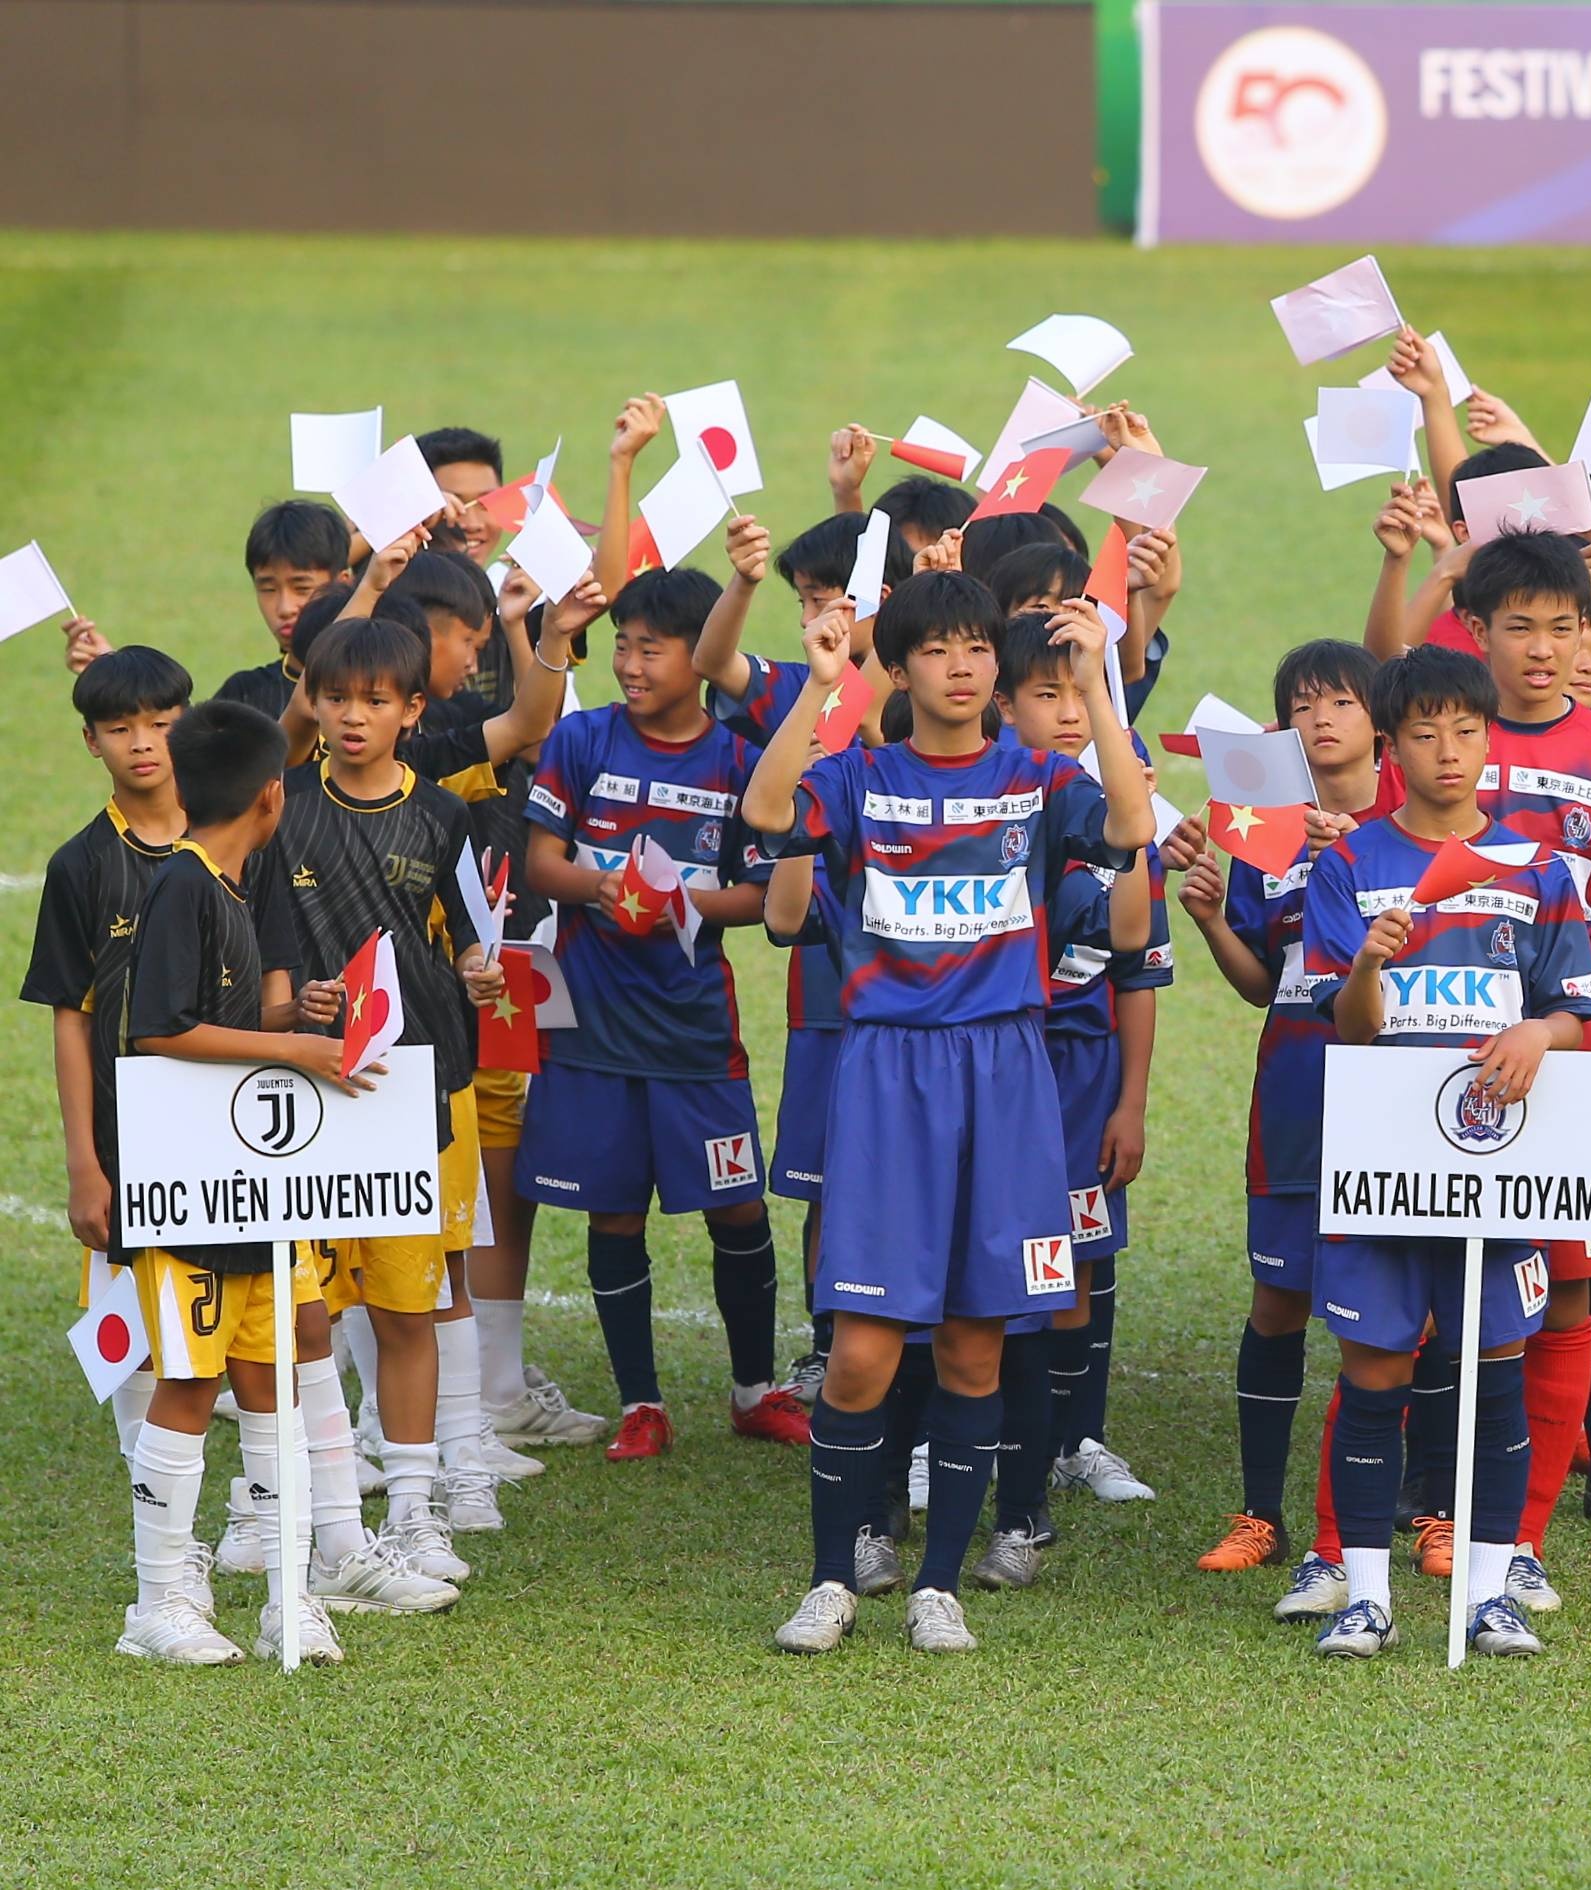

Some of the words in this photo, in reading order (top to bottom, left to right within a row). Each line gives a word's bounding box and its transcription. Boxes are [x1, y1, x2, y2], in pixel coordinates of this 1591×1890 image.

[531, 787, 562, 813] TOYAMA
[892, 879, 1009, 915] YKK
[1464, 893, 1535, 918] 東京海上日動
[934, 922, 956, 938] Big
[1389, 969, 1496, 1008] YKK
[1390, 1015, 1421, 1029] Parts.
[1426, 1013, 1447, 1031] Big
[1450, 1014, 1508, 1032] Difference
[256, 1079, 294, 1089] JUVENTUS
[535, 1176, 580, 1191] GOLDWIN
[785, 1169, 823, 1184] GOLDWI
[126, 1180, 188, 1235] HỌC
[201, 1169, 269, 1233] VIỆN
[283, 1170, 433, 1221] JUVENTUS
[1332, 1170, 1483, 1219] KATALLER
[1252, 1251, 1285, 1268] GOLDWIN
[834, 1281, 886, 1296] GOLDWIN
[1326, 1301, 1360, 1321] GOLDWIN
